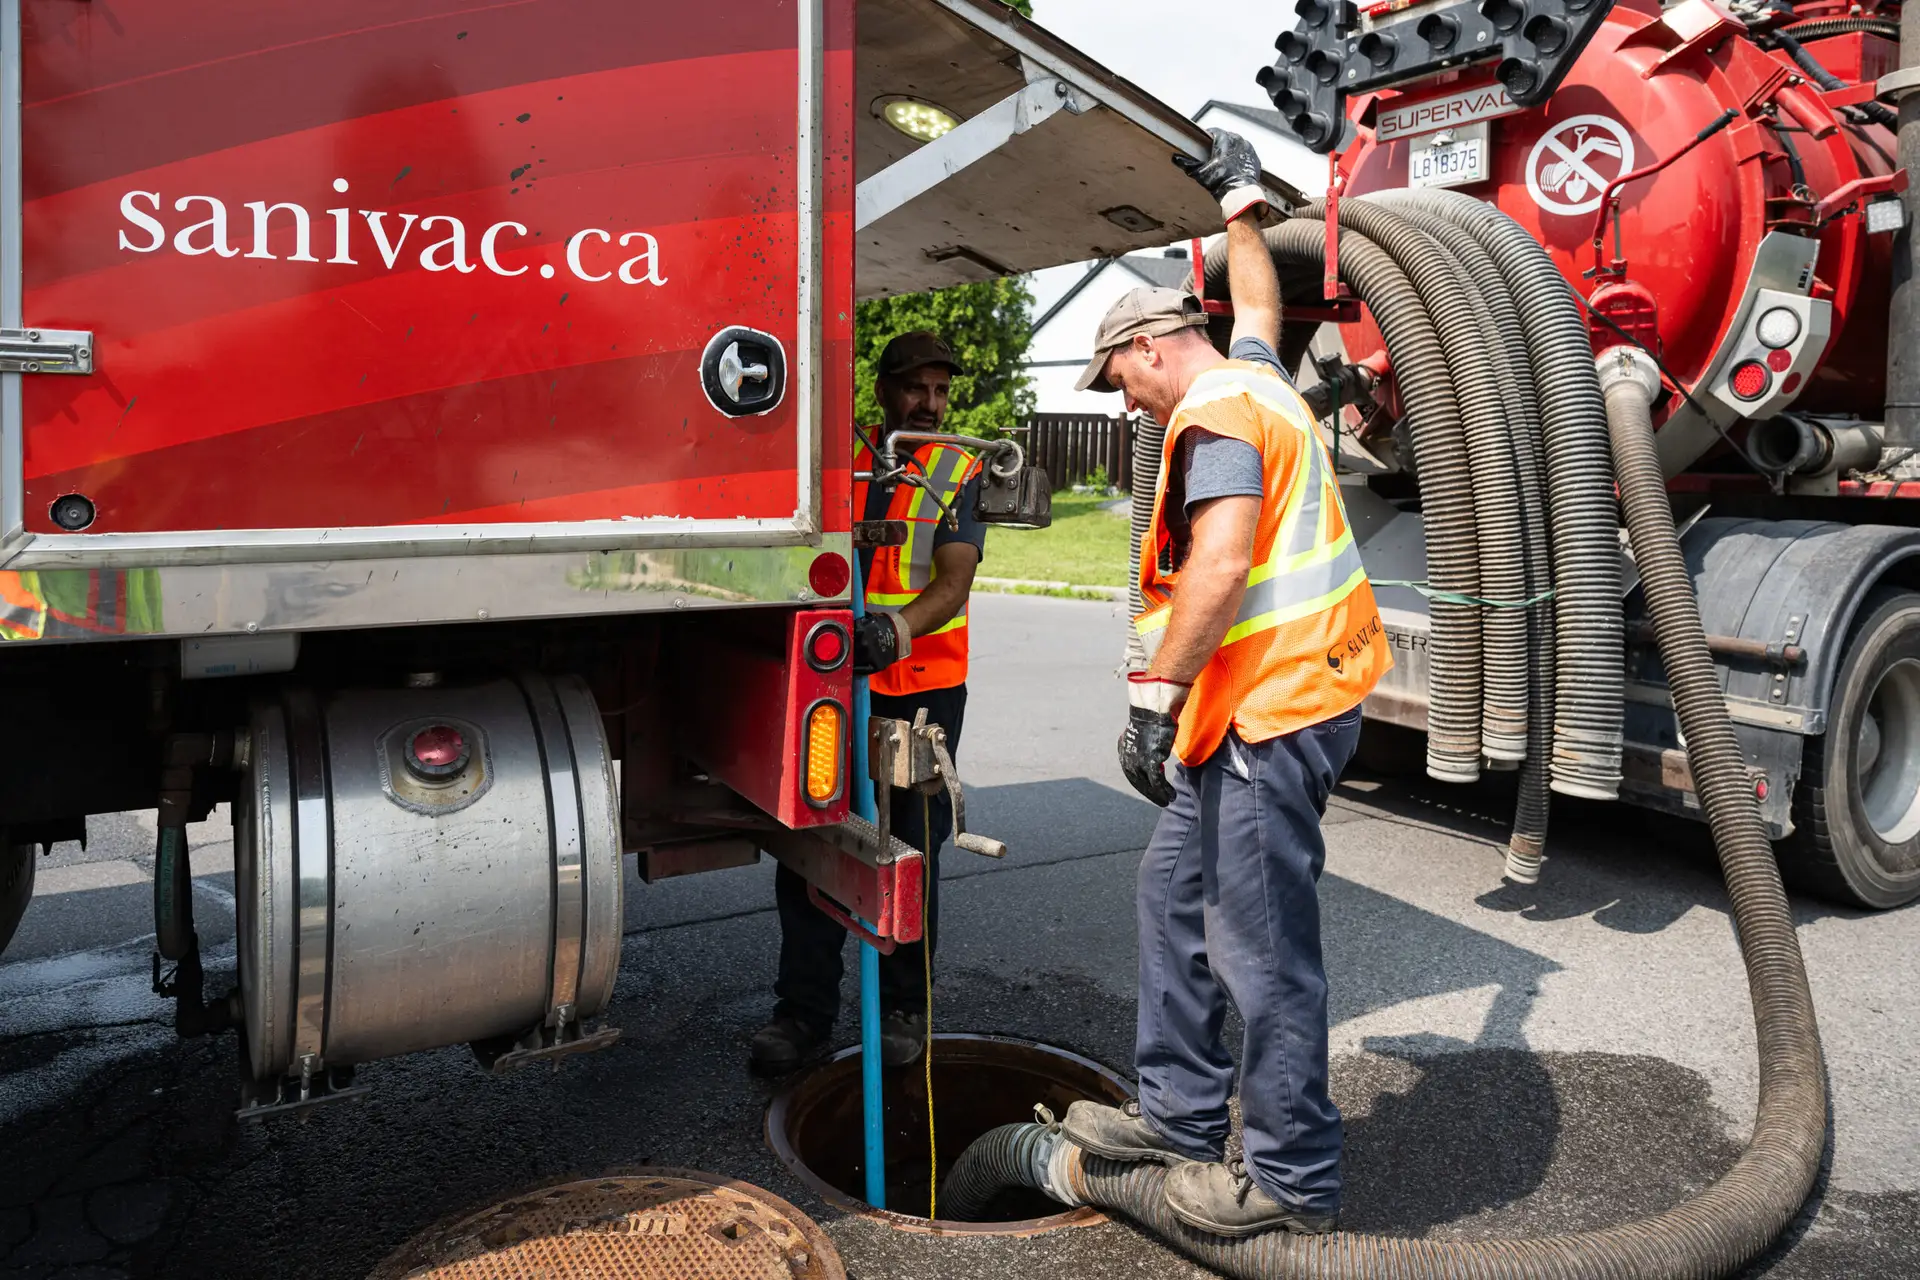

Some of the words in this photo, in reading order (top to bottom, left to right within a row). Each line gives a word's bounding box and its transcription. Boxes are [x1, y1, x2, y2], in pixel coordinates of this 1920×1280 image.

[1413, 149, 1477, 179] L818375
[118, 177, 669, 287] sanivac.ca
[1384, 630, 1432, 653] PER
